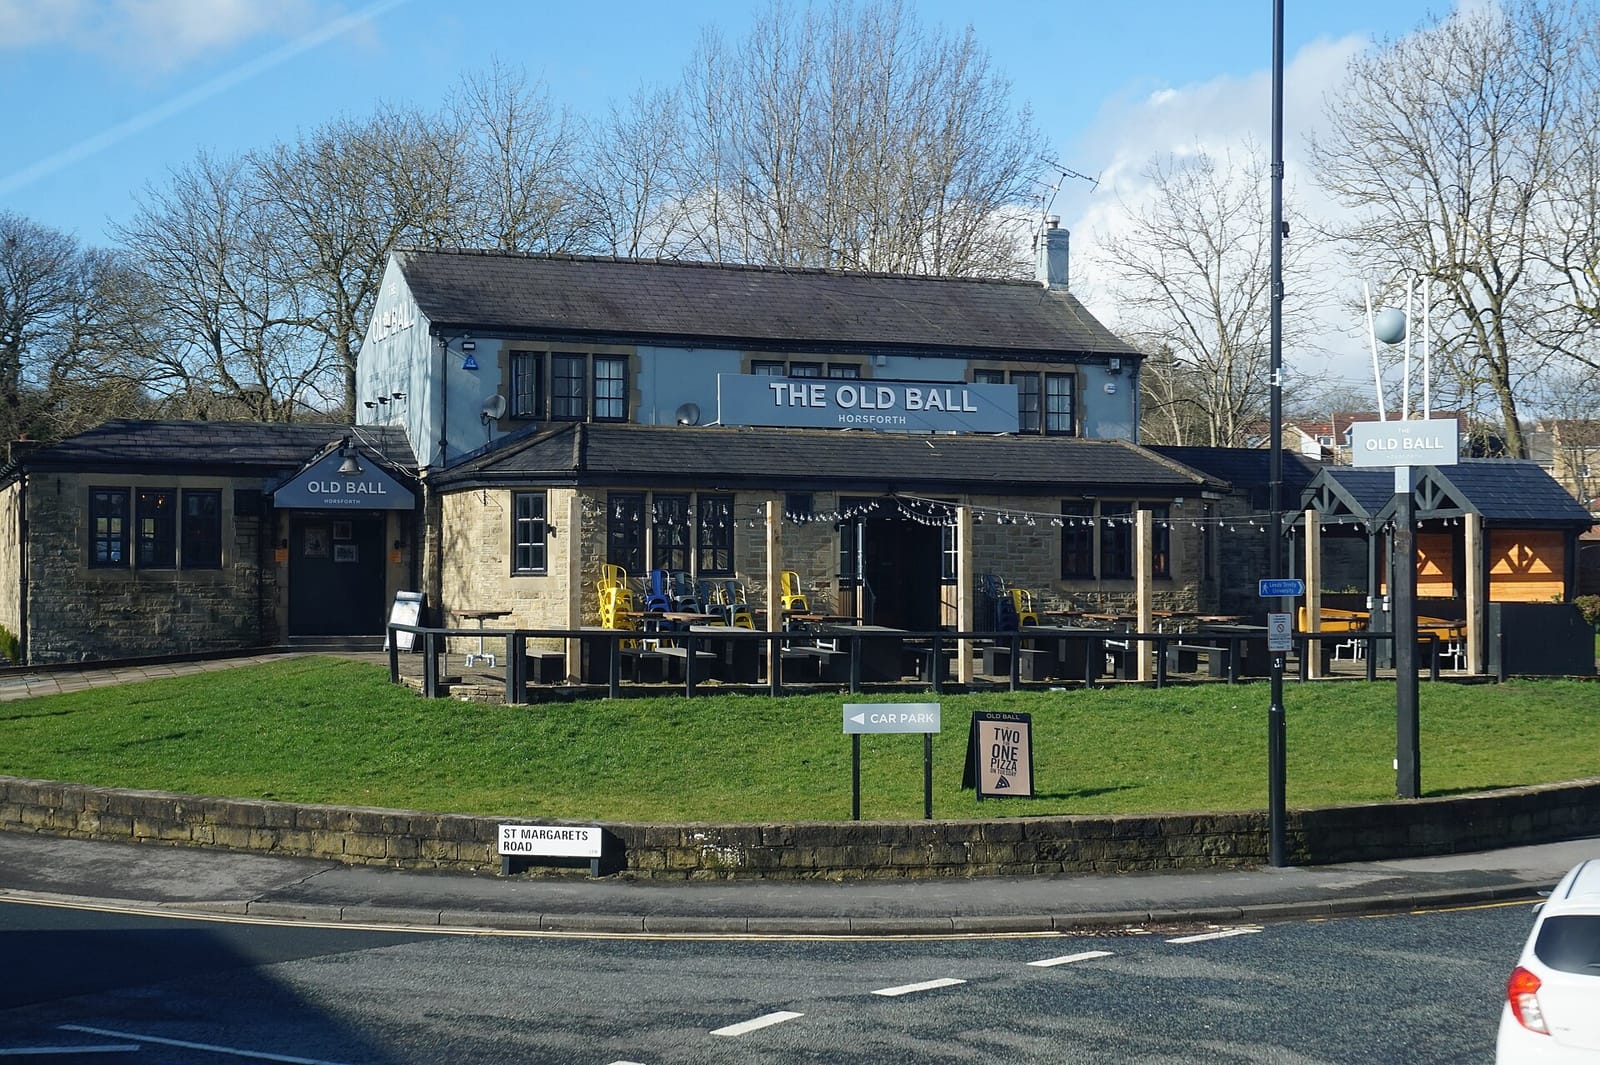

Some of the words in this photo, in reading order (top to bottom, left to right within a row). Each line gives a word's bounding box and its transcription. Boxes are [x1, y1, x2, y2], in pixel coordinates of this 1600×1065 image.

[391, 298, 414, 337] BALL
[769, 383, 827, 408] THE
[836, 386, 896, 410] OLD
[904, 388, 978, 412] BALL
[838, 413, 907, 425] HORSFORTH
[1366, 438, 1398, 451] OLD
[1403, 436, 1444, 450] BALL
[308, 481, 341, 494] OLD
[346, 482, 387, 495] BALL
[870, 713, 897, 724] CAR
[900, 713, 935, 724] PARK
[994, 727, 1020, 744] TWO
[992, 743, 1019, 762] ONE
[990, 758, 1017, 771] PIZZA
[503, 828, 518, 839] ST
[521, 829, 589, 841] MARGARETS
[503, 841, 533, 852] ROAD
